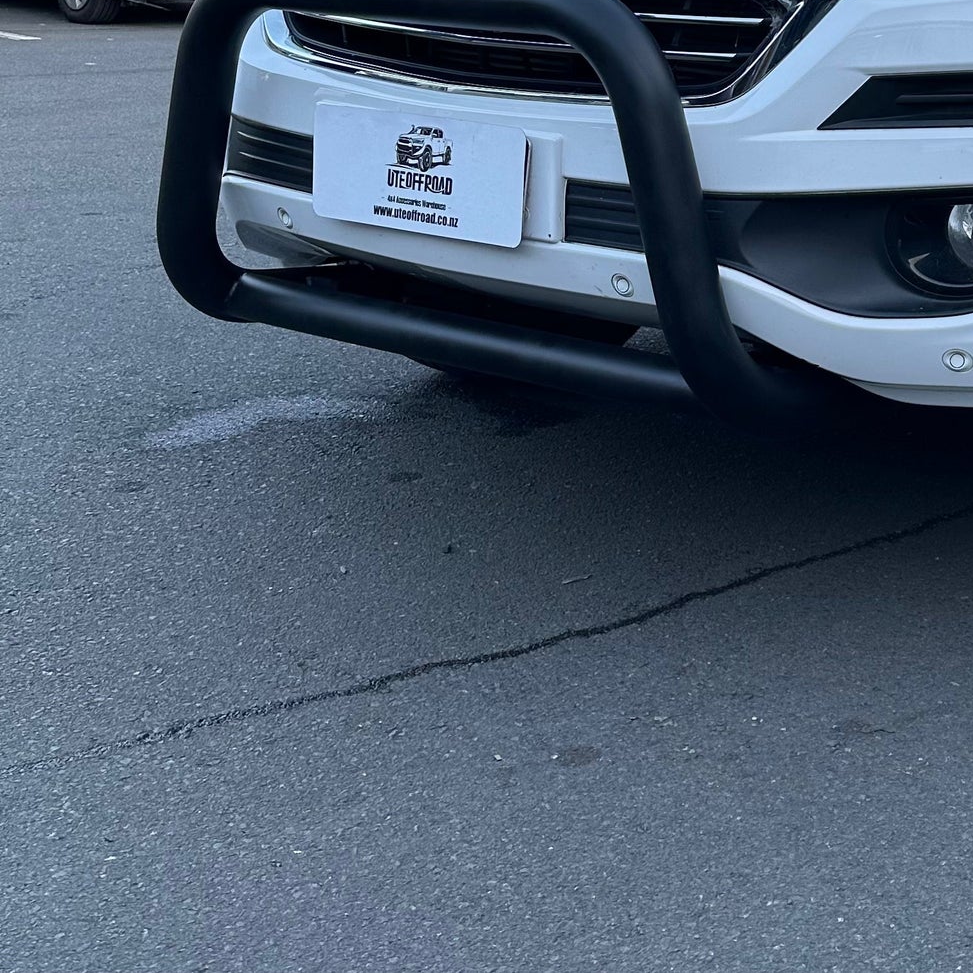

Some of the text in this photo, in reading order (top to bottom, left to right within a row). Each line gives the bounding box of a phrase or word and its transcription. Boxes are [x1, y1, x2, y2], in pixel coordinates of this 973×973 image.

[387, 168, 453, 195] UTEOFFROAD
[373, 205, 459, 227] www.uteoffroad.co.nz
[422, 199, 447, 211] Warehouse
